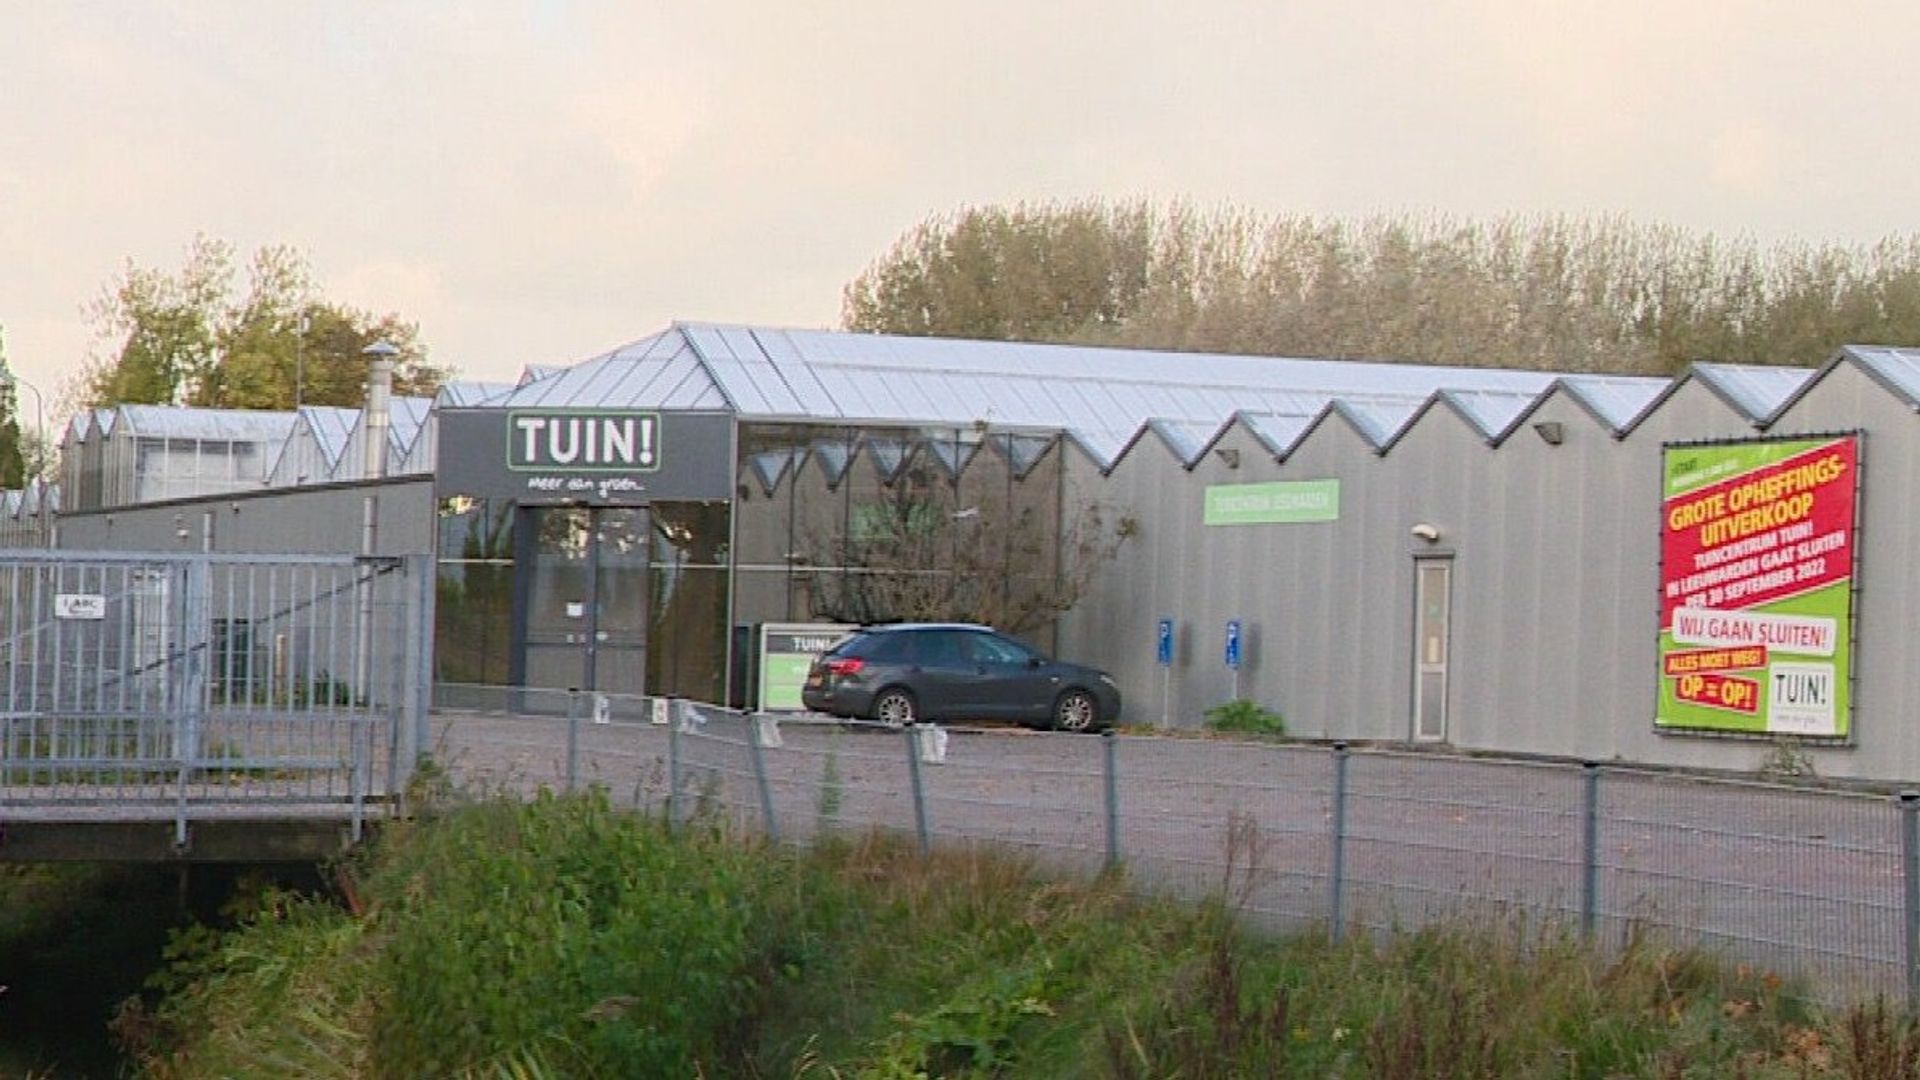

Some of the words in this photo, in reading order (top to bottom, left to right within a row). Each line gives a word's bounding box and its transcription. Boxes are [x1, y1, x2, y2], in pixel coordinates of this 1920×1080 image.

[516, 417, 653, 464] TUIN!
[1669, 493, 1727, 531] GROTE
[1728, 454, 1846, 512] OPHEFFINGS-
[1701, 493, 1814, 547] UITVERKOOP
[1666, 581, 1680, 598] IN
[1680, 557, 1759, 595] LEEUWARDEN
[1760, 545, 1796, 569] GAAT
[1797, 530, 1846, 558] SLUITEN
[1694, 532, 1778, 569] TUINCENTRUM
[1779, 519, 1814, 544] TUIN!
[1724, 568, 1795, 598] SEPTEMBER
[1796, 558, 1826, 580] 2022
[1680, 614, 1704, 636] WIJ
[1708, 620, 1753, 641] GAAN
[1759, 623, 1828, 649] SLUITEN!
[1668, 654, 1699, 674] ALLES
[1699, 652, 1731, 669] MOET
[1680, 674, 1704, 698] OP
[1721, 680, 1752, 708] OP!
[1775, 674, 1827, 705] TUIN!
